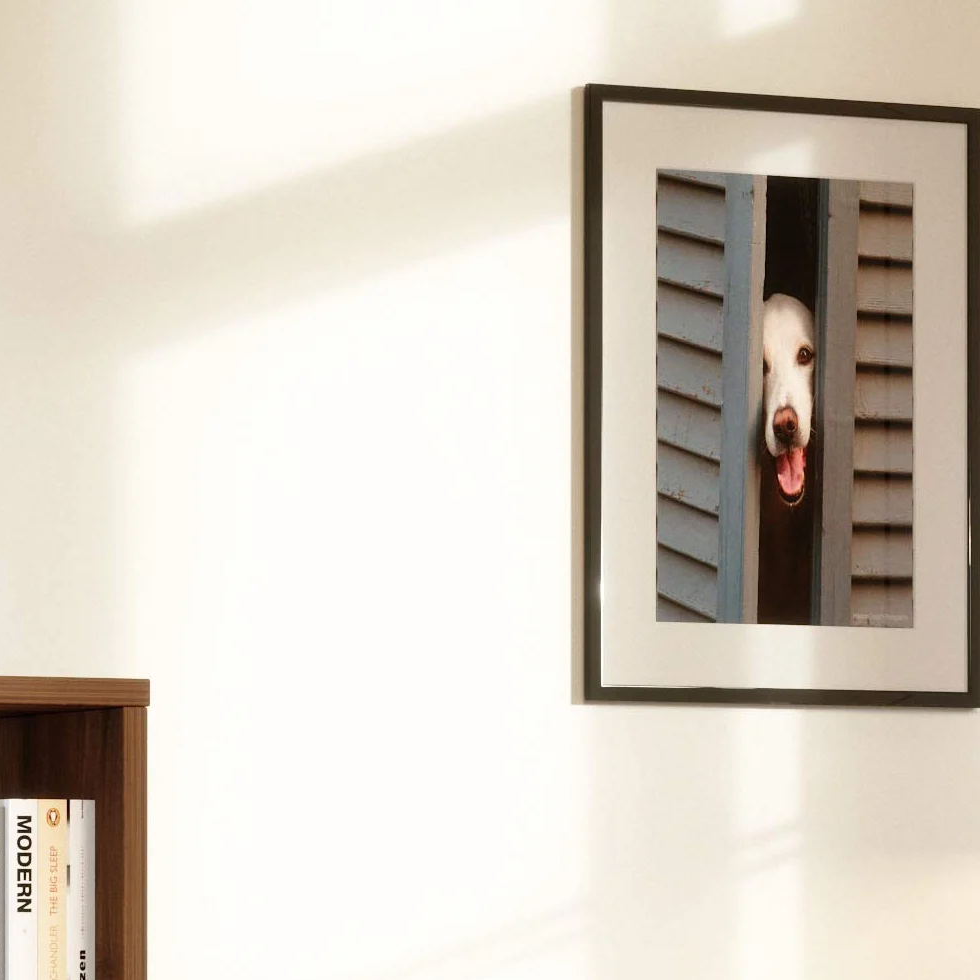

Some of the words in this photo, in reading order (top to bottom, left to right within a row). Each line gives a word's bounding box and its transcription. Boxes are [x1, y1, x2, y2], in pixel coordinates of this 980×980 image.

[16, 815, 32, 913] MODERN
[49, 846, 58, 873] SLEEP
[49, 876, 58, 893] BIG
[49, 897, 58, 916] THE
[49, 926, 58, 980] CHANDLER
